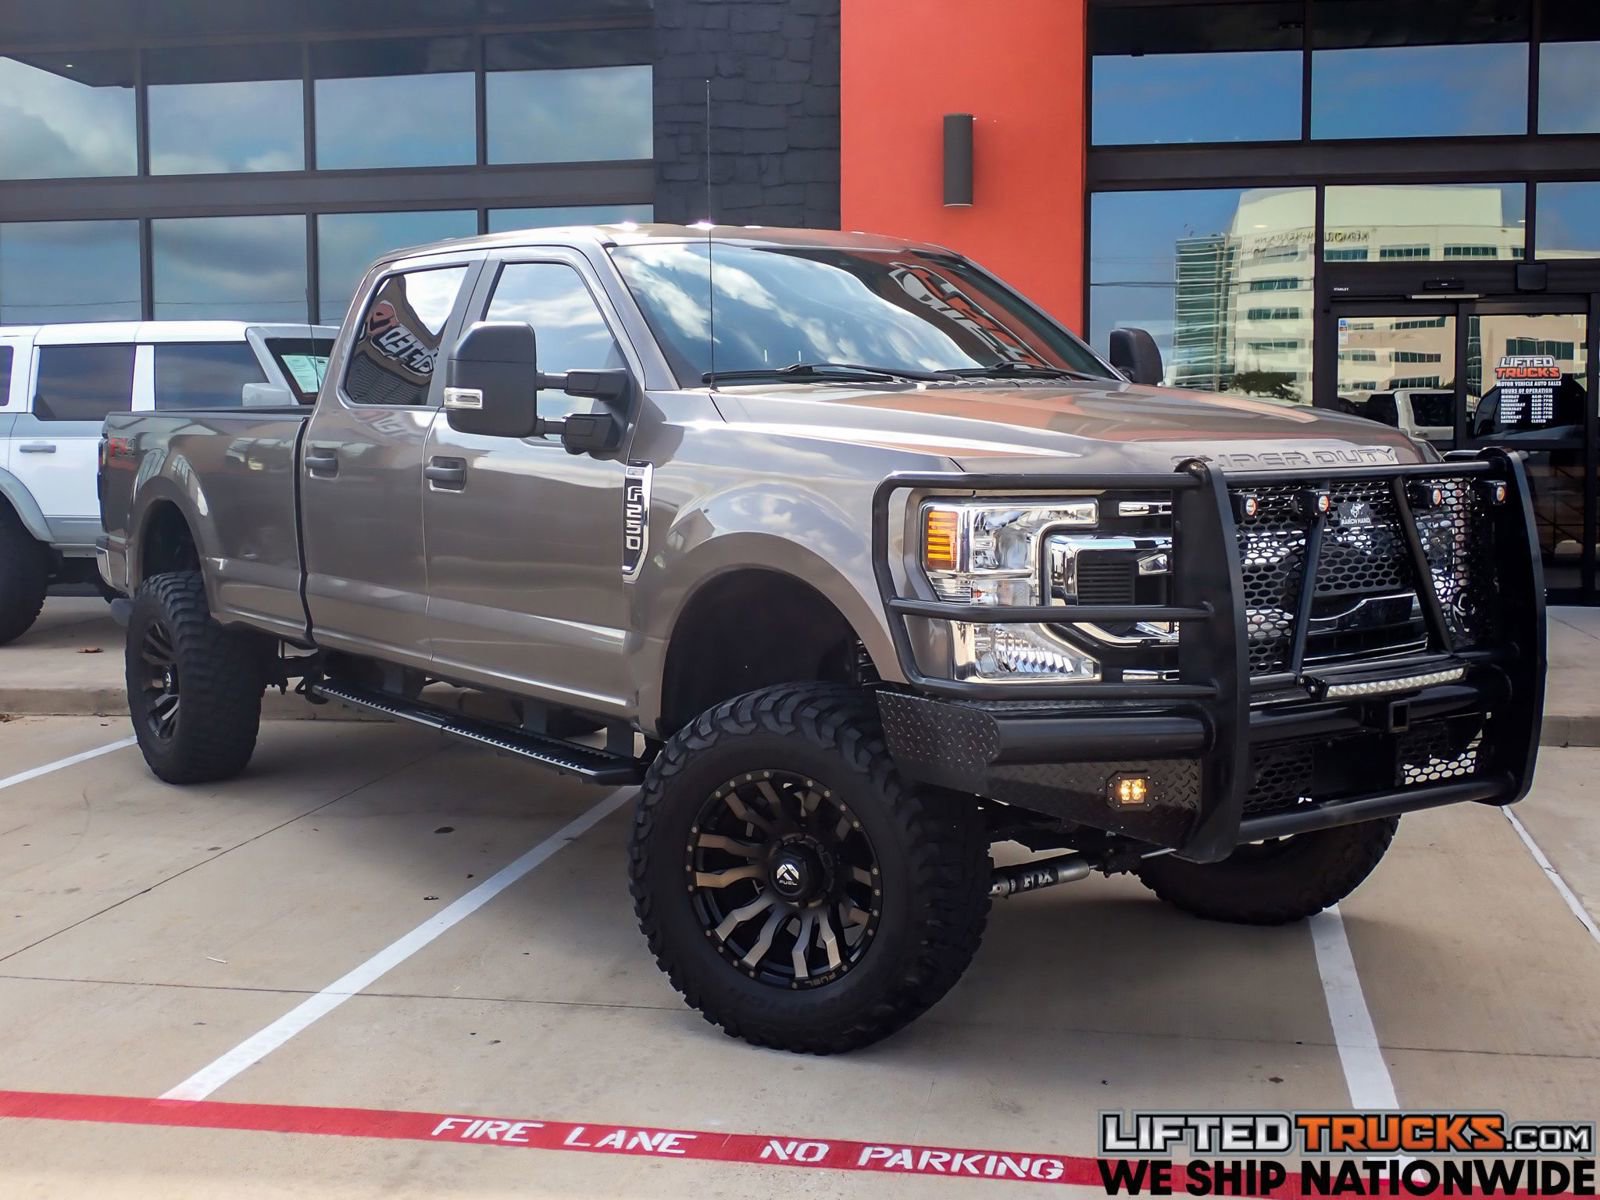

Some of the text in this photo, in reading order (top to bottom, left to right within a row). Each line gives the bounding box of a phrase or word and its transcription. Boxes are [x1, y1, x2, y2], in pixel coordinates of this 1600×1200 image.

[1501, 357, 1554, 368] LIFTED
[1495, 367, 1560, 379] TRUCKS
[1312, 447, 1396, 464] DUTY
[804, 972, 836, 987] FUEL
[431, 1117, 1065, 1180] FIRE LANE NO PARKING
